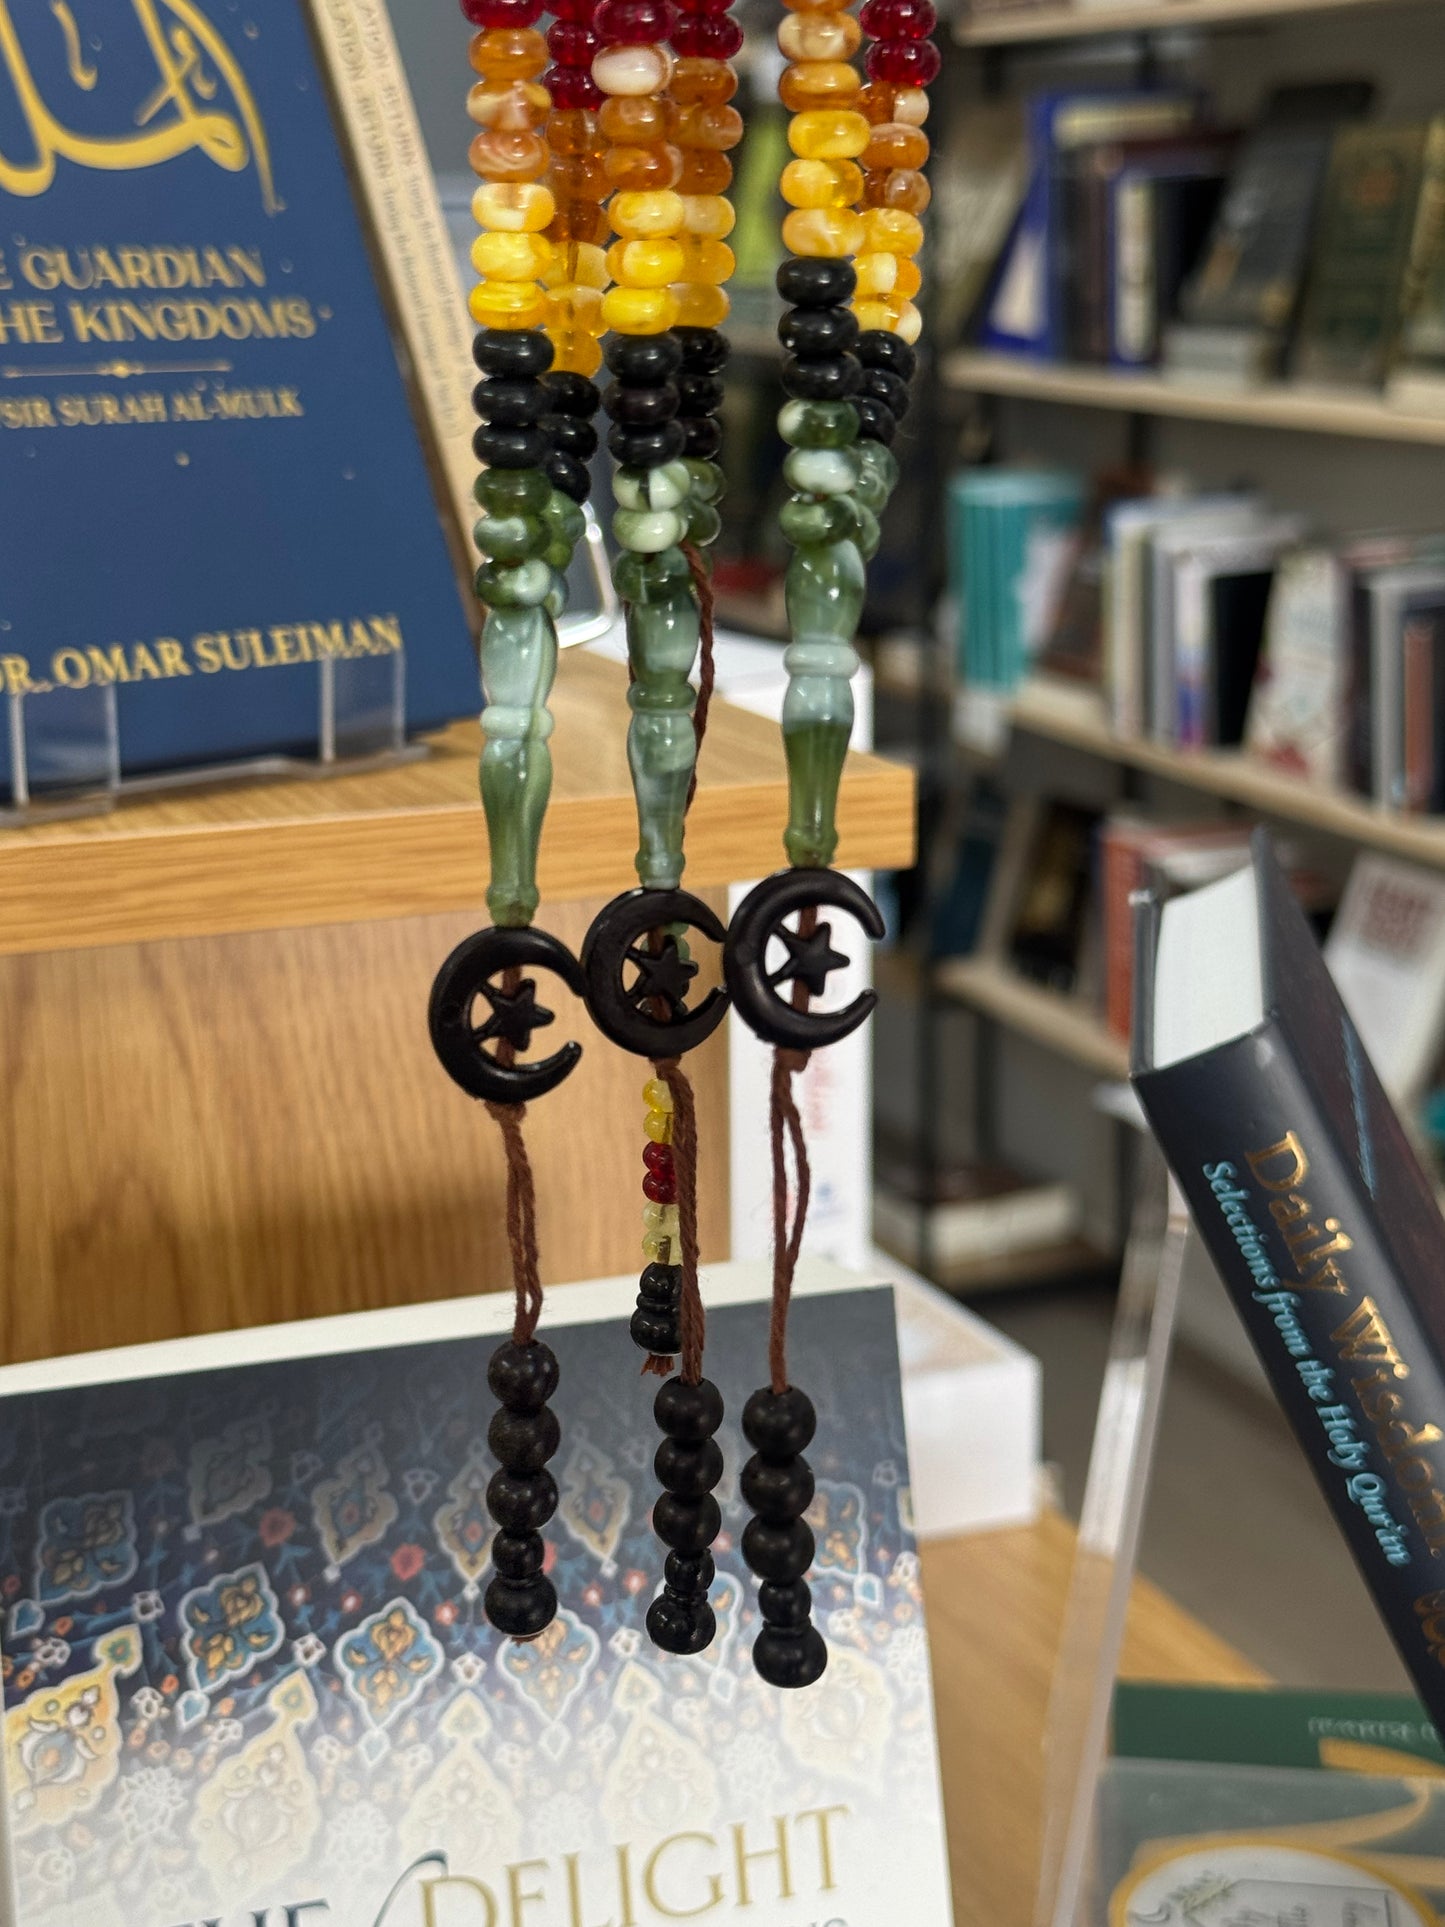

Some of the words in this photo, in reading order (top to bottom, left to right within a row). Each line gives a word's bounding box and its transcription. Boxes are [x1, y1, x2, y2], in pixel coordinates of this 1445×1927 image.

[20, 246, 266, 290] GUARDIAN
[69, 296, 316, 341] KINGDOMS
[57, 393, 168, 426] SURAH
[171, 387, 304, 421] AL-MULK
[0, 654, 53, 694] R.
[52, 643, 192, 690] OMAR
[194, 614, 402, 674] SULEIMAN
[1245, 1130, 1354, 1296] Daily
[1202, 1161, 1281, 1289] Selections
[1252, 1290, 1312, 1357] from
[1295, 1360, 1336, 1401] the
[1316, 1404, 1370, 1470] Holy
[417, 1804, 849, 1927] DELIGHT
